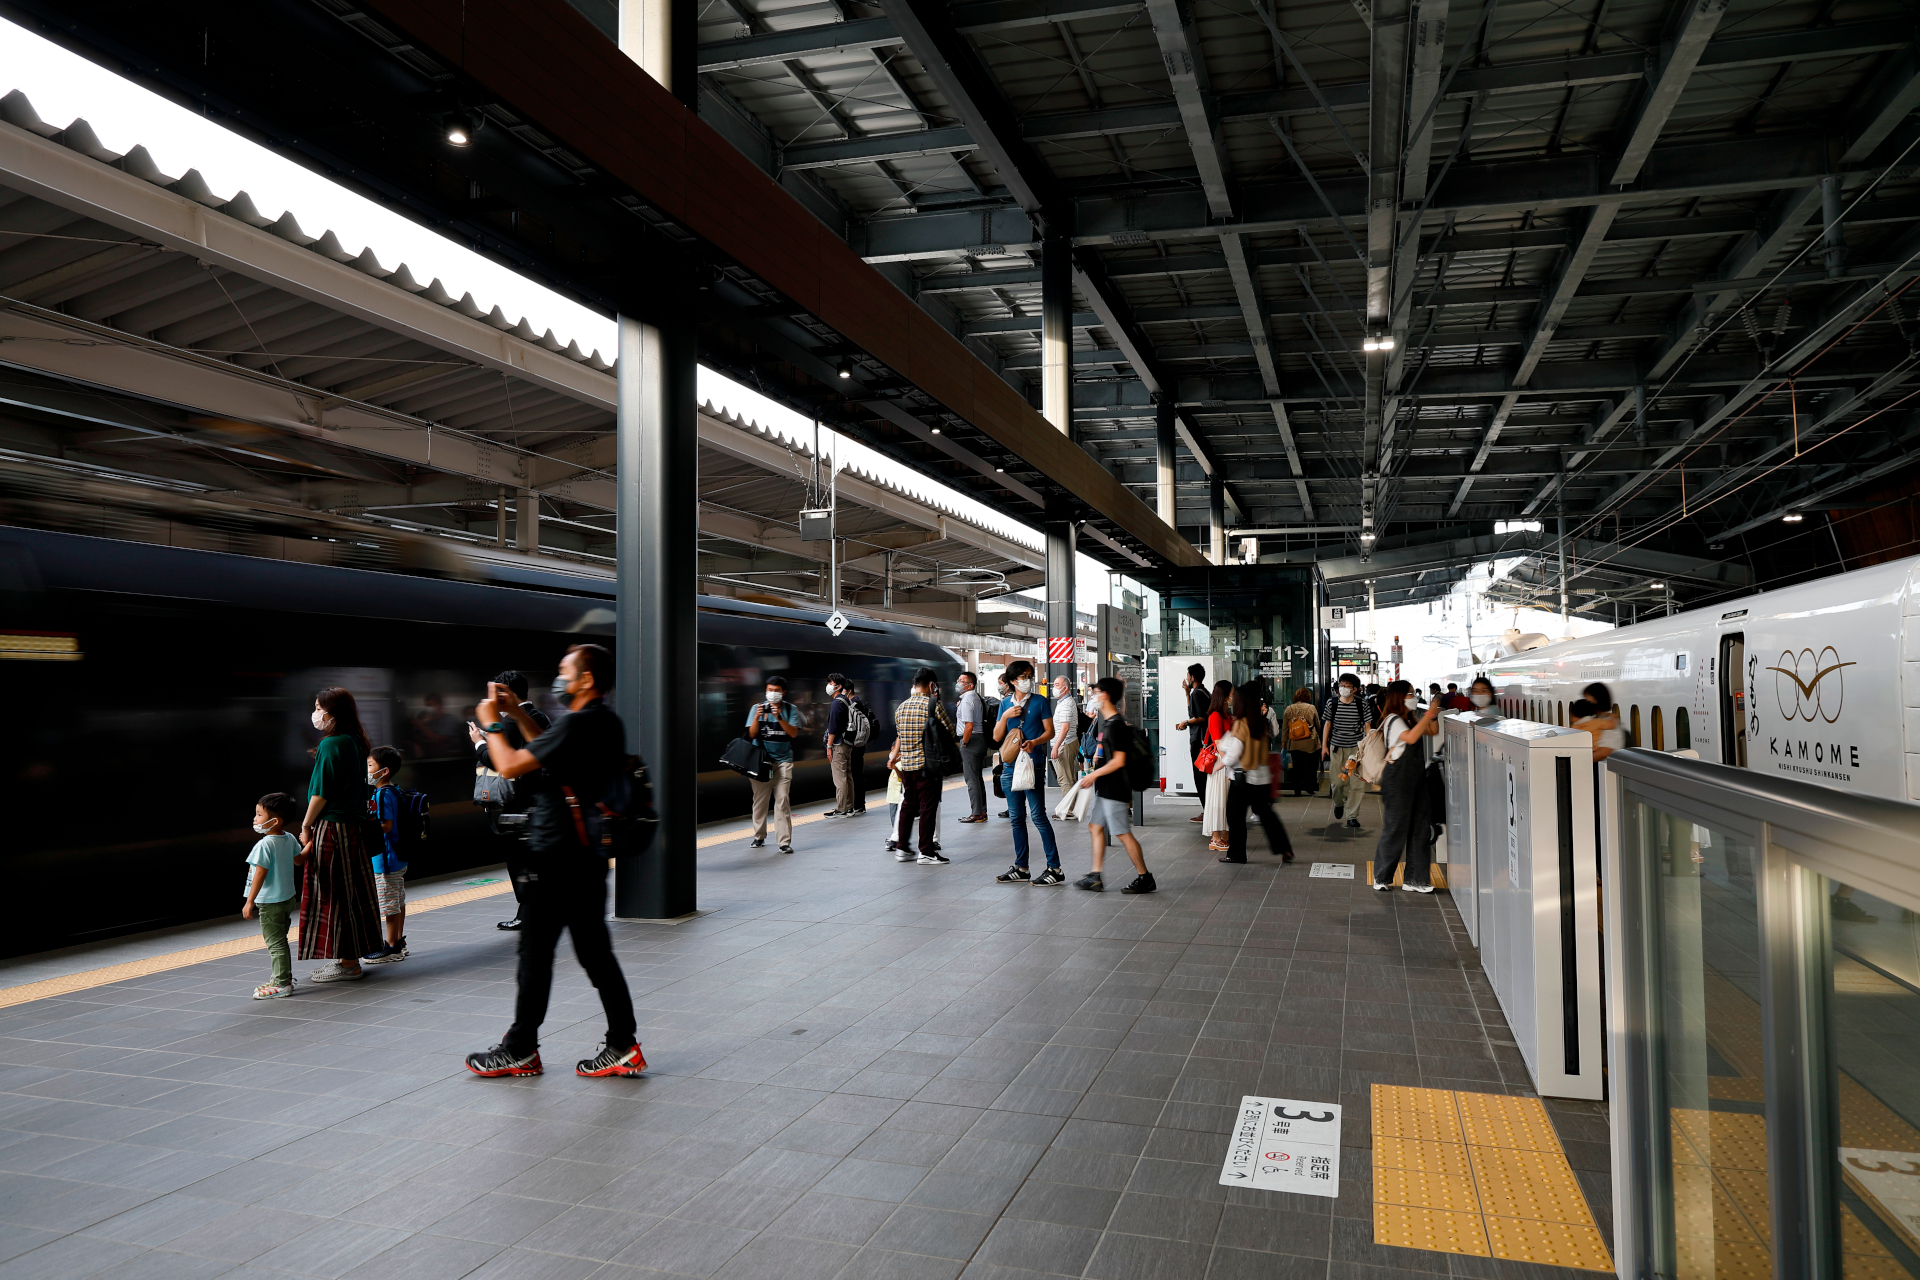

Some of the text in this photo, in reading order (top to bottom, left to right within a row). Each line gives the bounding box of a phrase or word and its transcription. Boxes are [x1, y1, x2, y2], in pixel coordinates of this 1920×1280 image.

[833, 617, 842, 630] 2
[1274, 645, 1292, 661] 11
[1749, 654, 1760, 736] かもめ
[1694, 737, 1710, 745] KAMOME
[1769, 736, 1860, 768] KAMOME
[1778, 763, 1851, 782] NISHI KYUSHU SHINKANSEN
[1508, 772, 1515, 827] 3
[1272, 1106, 1335, 1135] 3 号車
[1232, 1110, 1262, 1168] 2列にお並びください
[1294, 1156, 1307, 1177] Reserved
[1310, 1156, 1331, 1180] 指定席
[1845, 1157, 1920, 1176] 3
